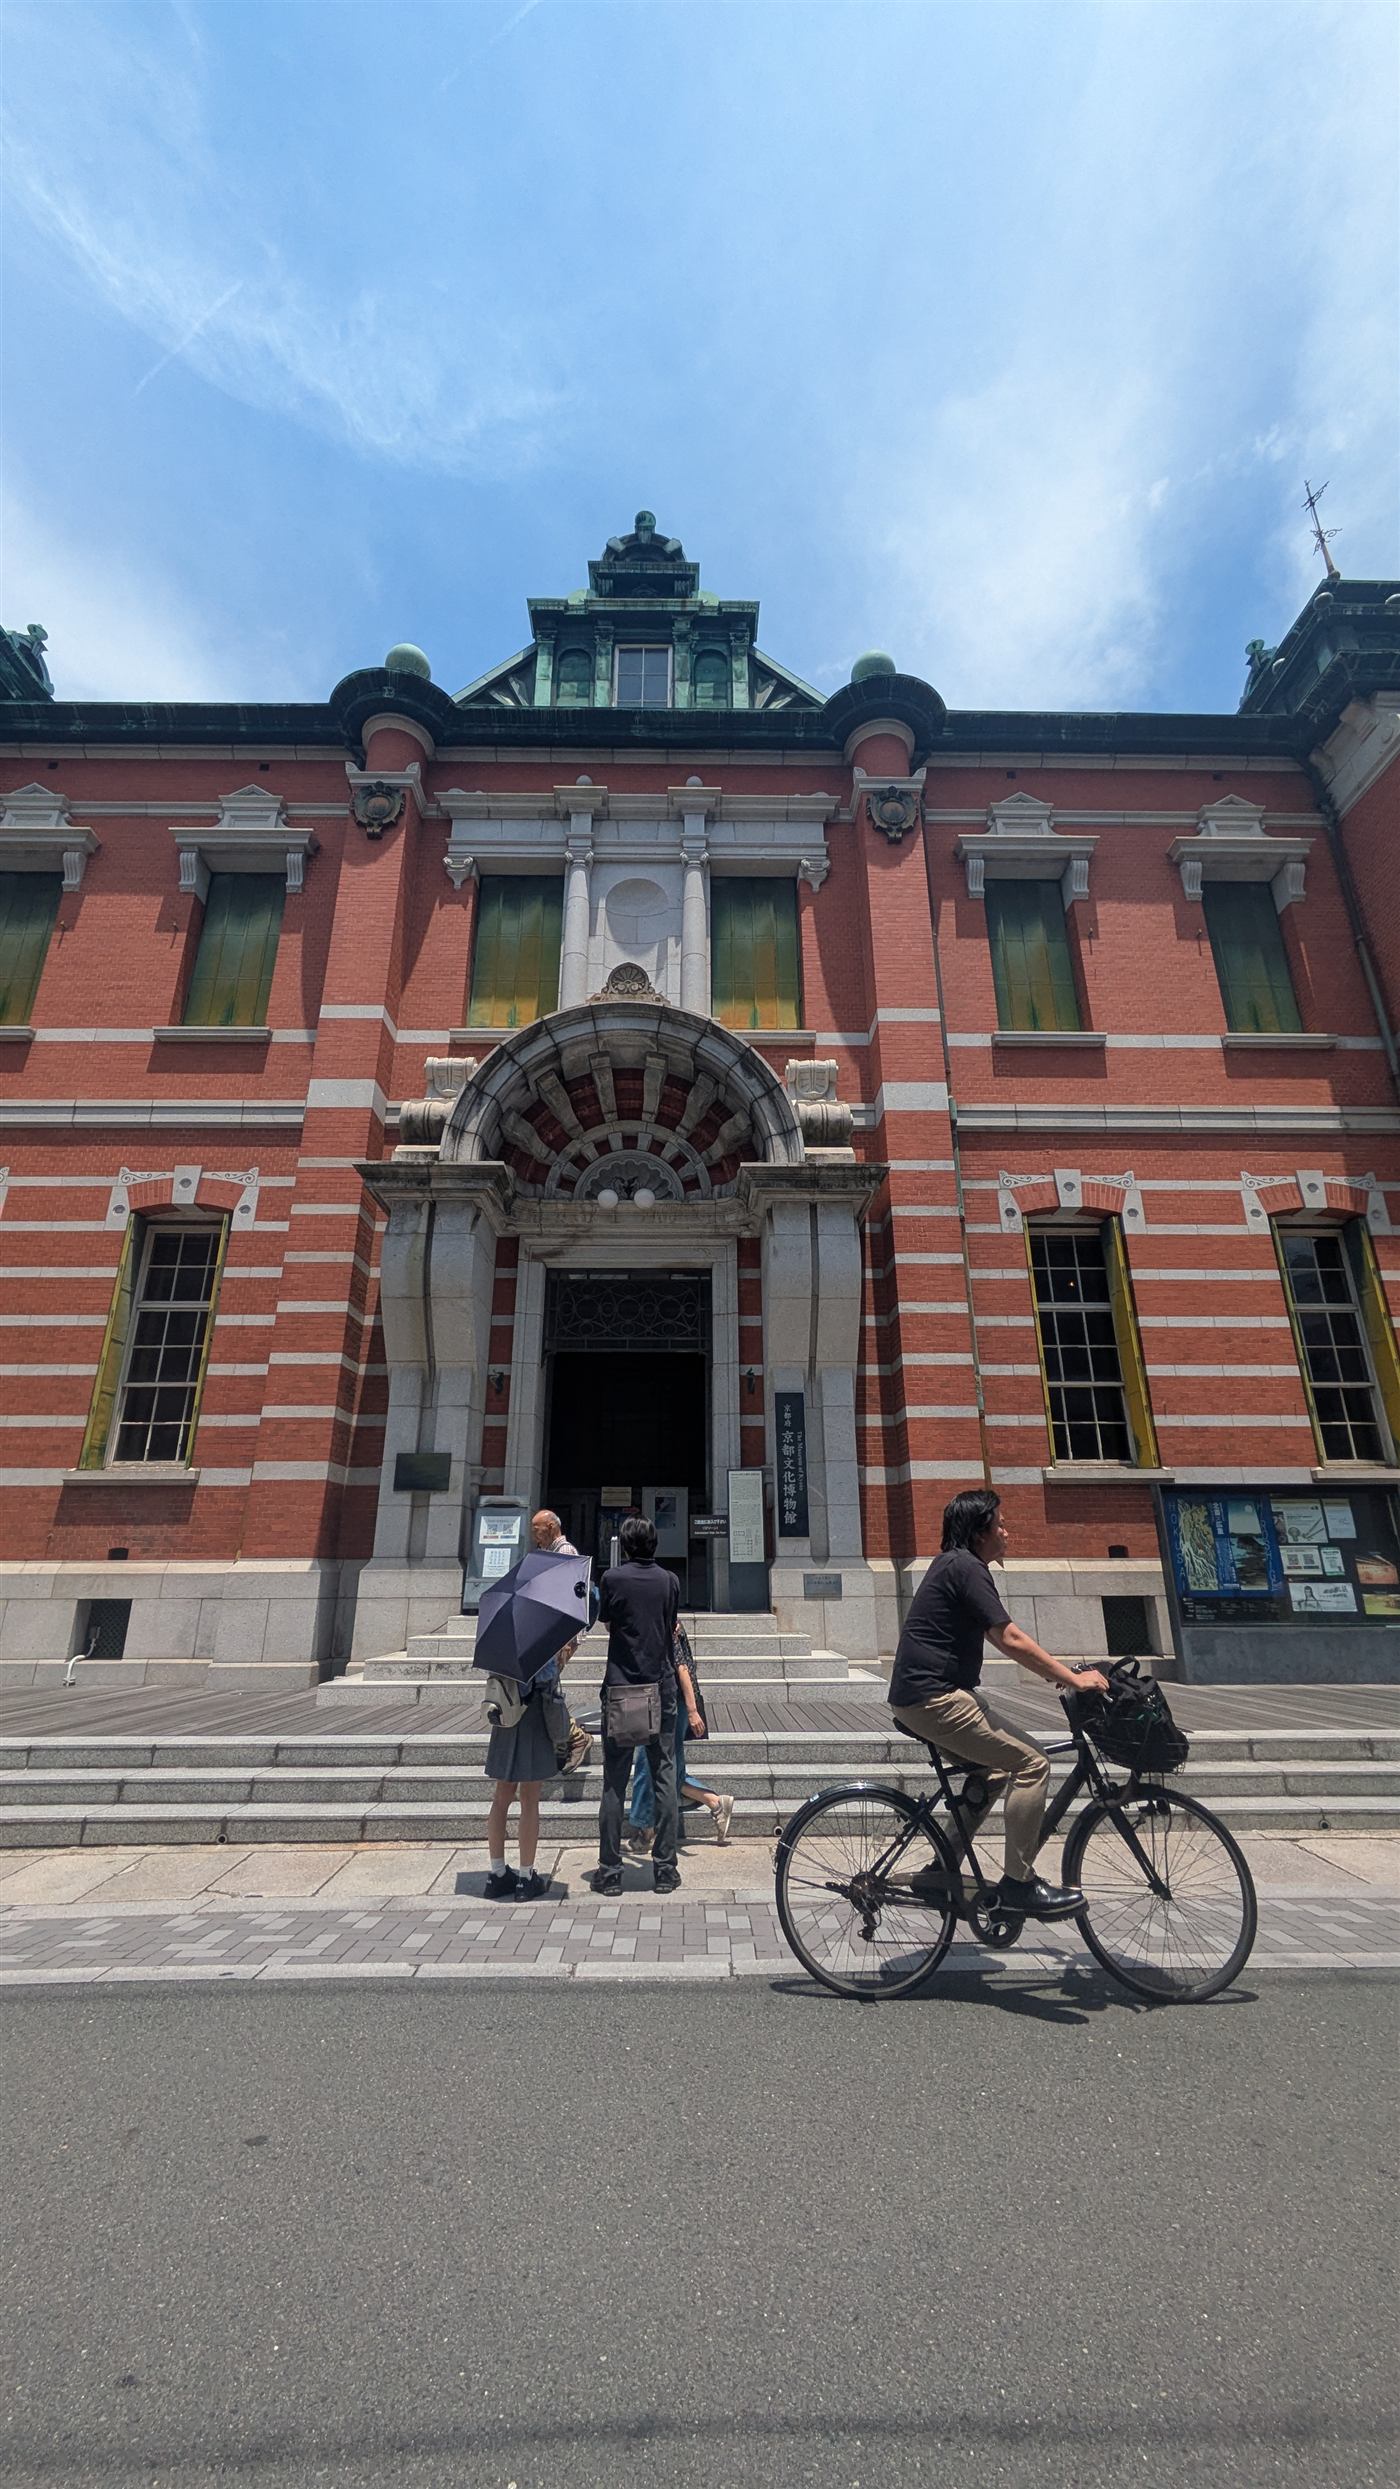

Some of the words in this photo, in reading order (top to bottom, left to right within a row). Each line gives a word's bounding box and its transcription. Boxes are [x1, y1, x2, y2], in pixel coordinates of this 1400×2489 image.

[783, 1402, 792, 1427] 京都府
[781, 1430, 797, 1525] 京都文化博物館
